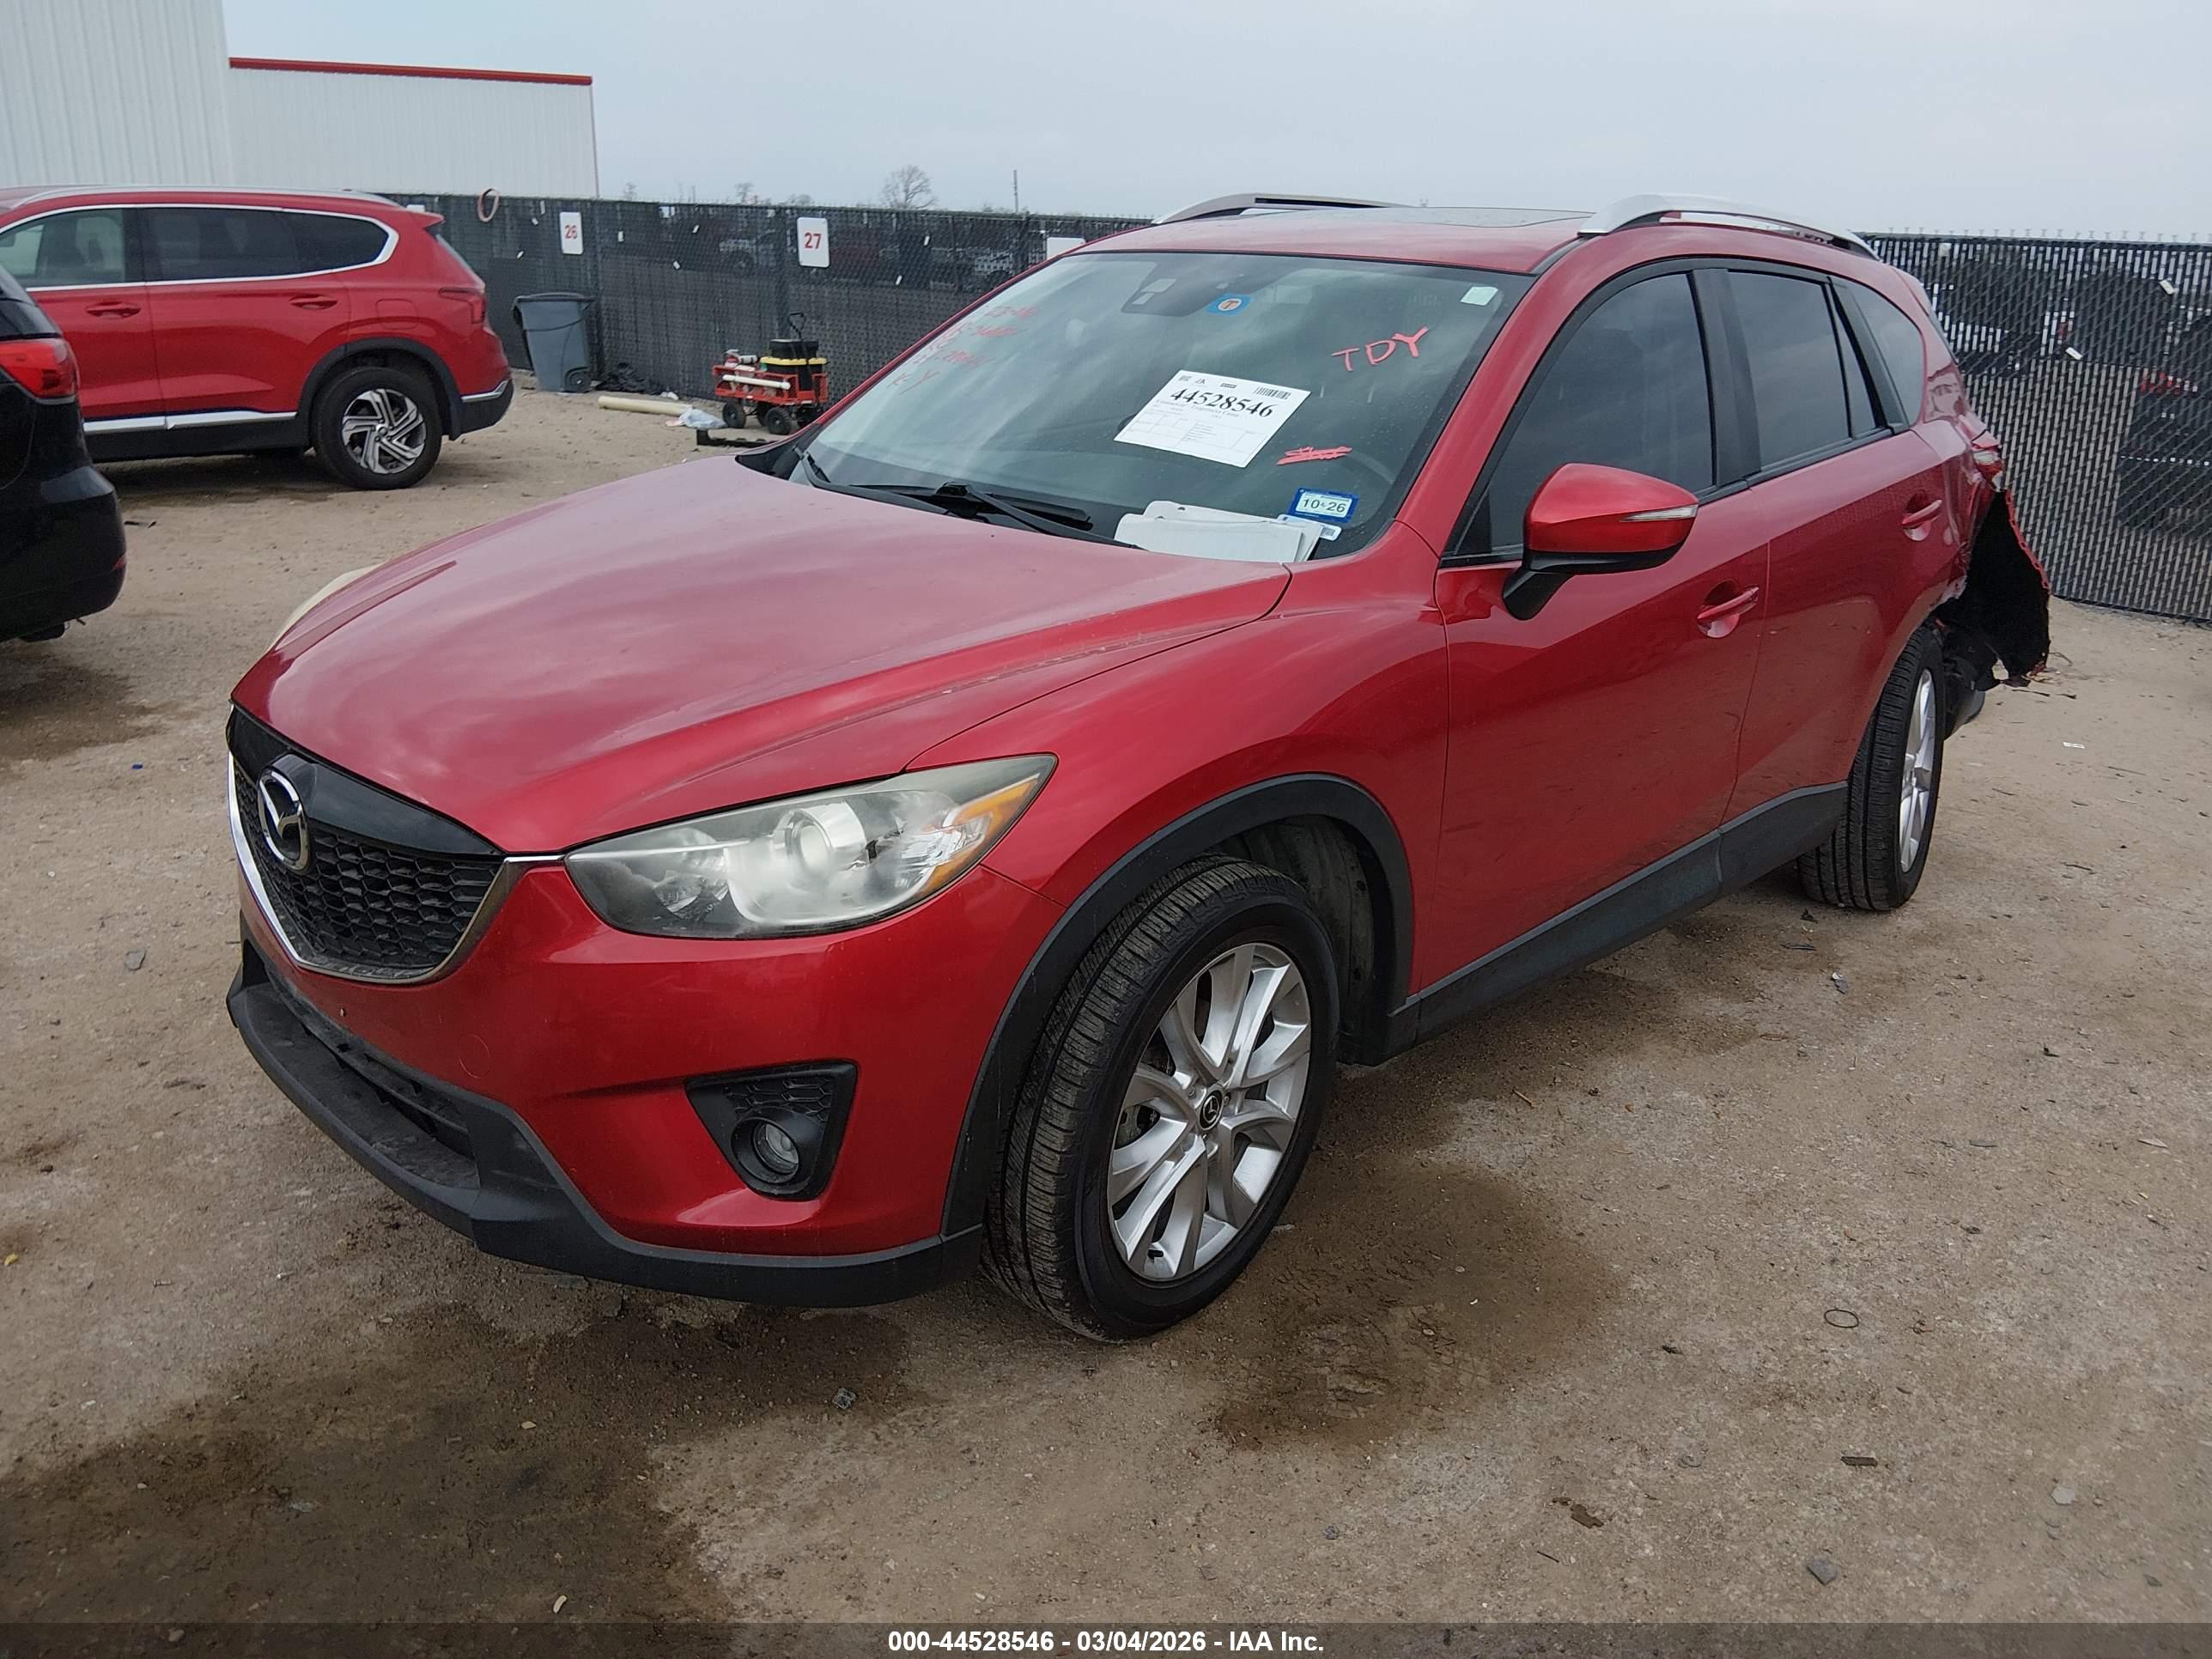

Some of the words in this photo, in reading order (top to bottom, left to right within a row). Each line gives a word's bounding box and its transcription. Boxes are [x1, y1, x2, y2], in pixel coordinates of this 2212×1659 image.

[804, 232, 822, 249] 27
[1332, 326, 1429, 372] TDY
[1170, 387, 1278, 418] 44528546
[1303, 498, 1320, 509] 10
[1326, 501, 1346, 513] 26
